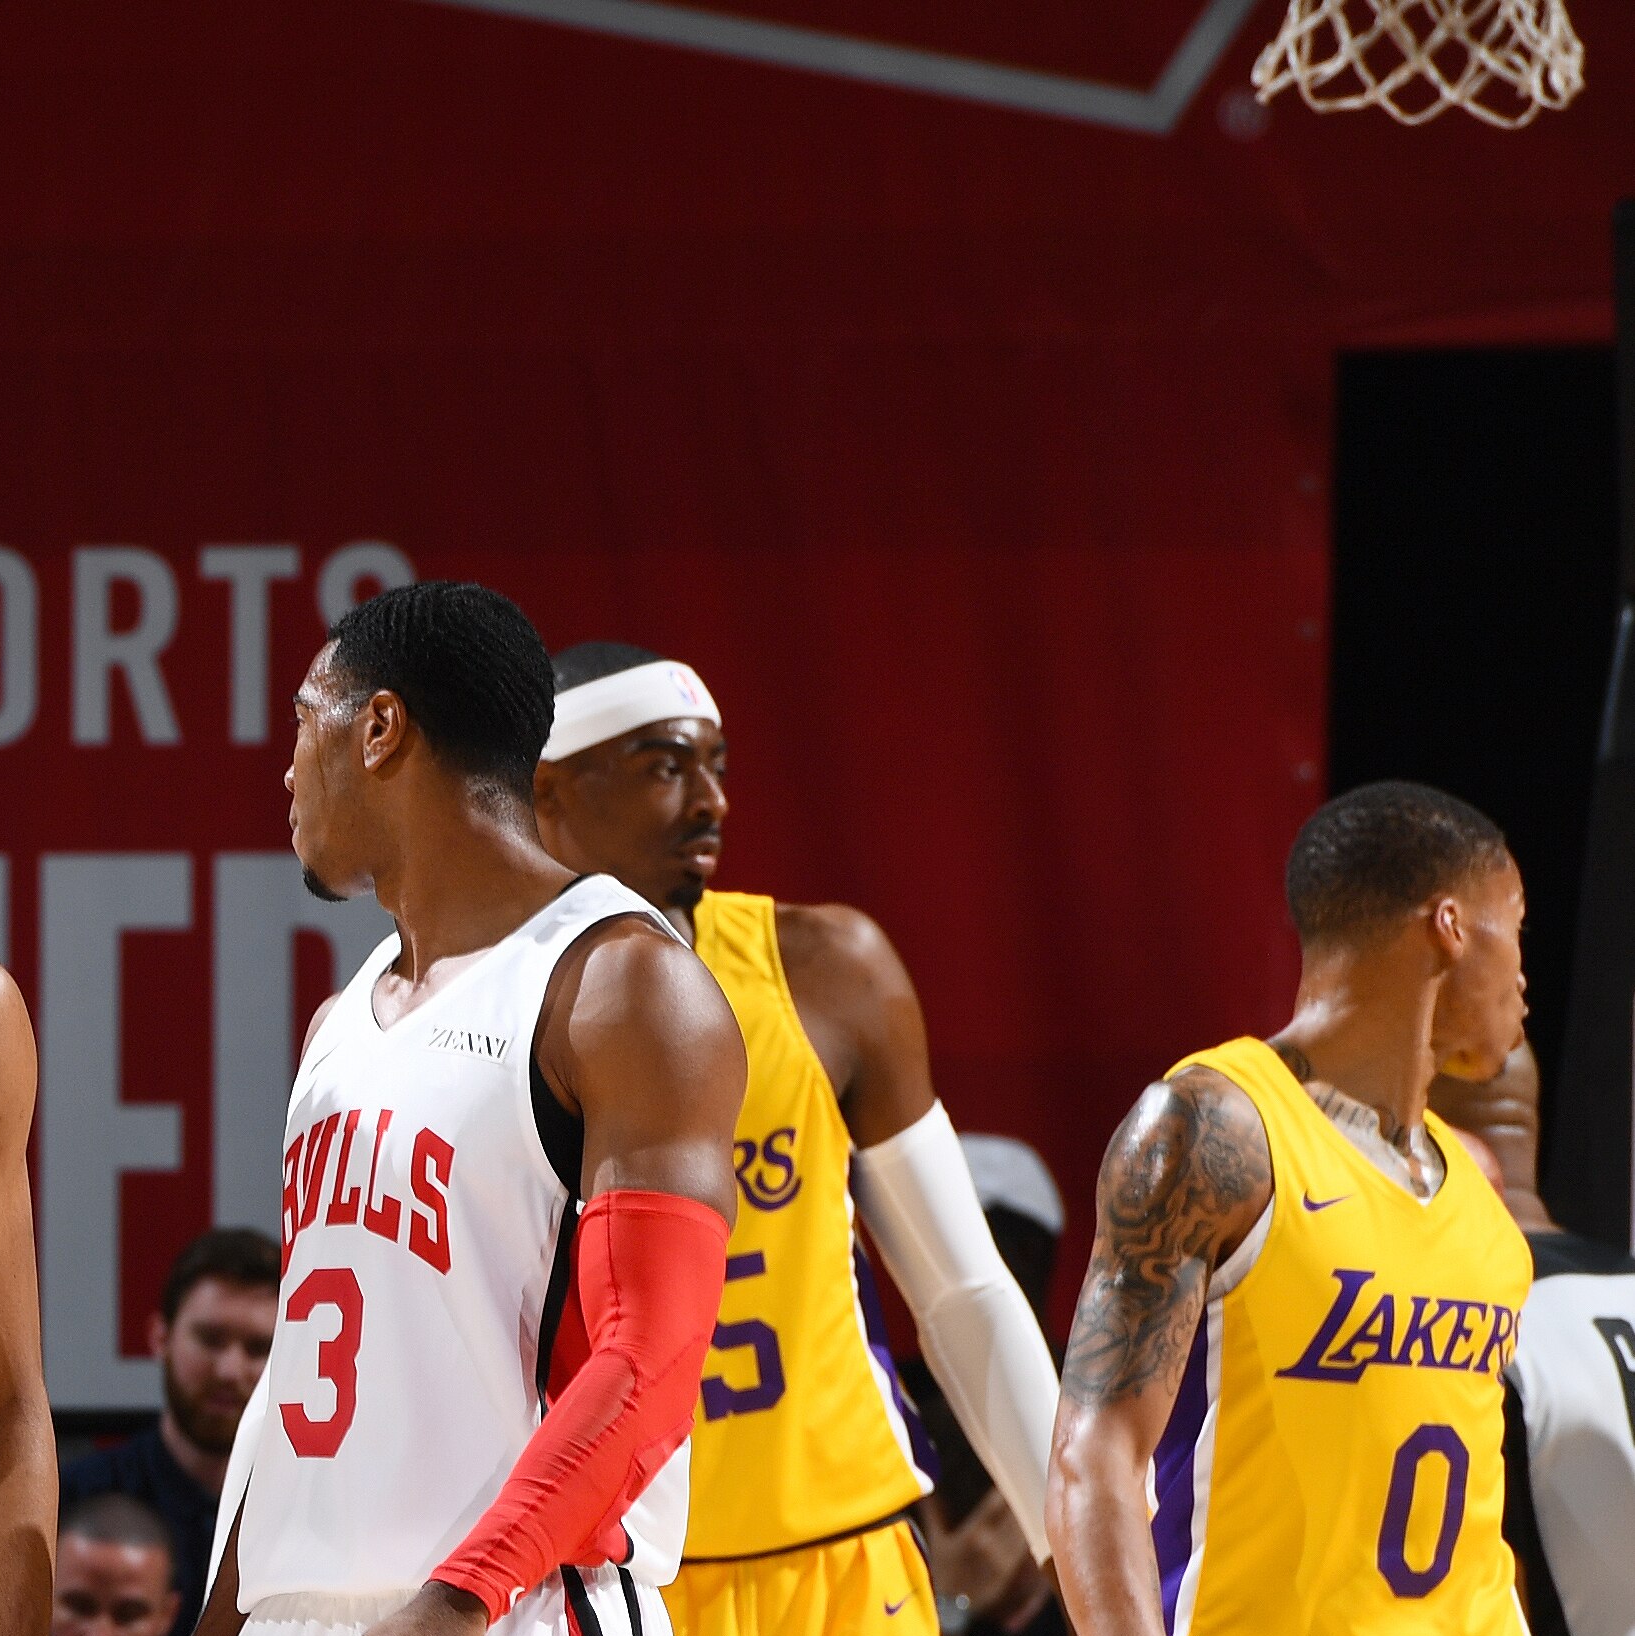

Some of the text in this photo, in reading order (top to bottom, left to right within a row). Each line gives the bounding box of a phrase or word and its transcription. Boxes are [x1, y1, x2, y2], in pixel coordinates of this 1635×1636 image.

[279, 1109, 456, 1281] BULLS
[278, 1267, 364, 1458] 3
[1377, 1424, 1469, 1599] 0
